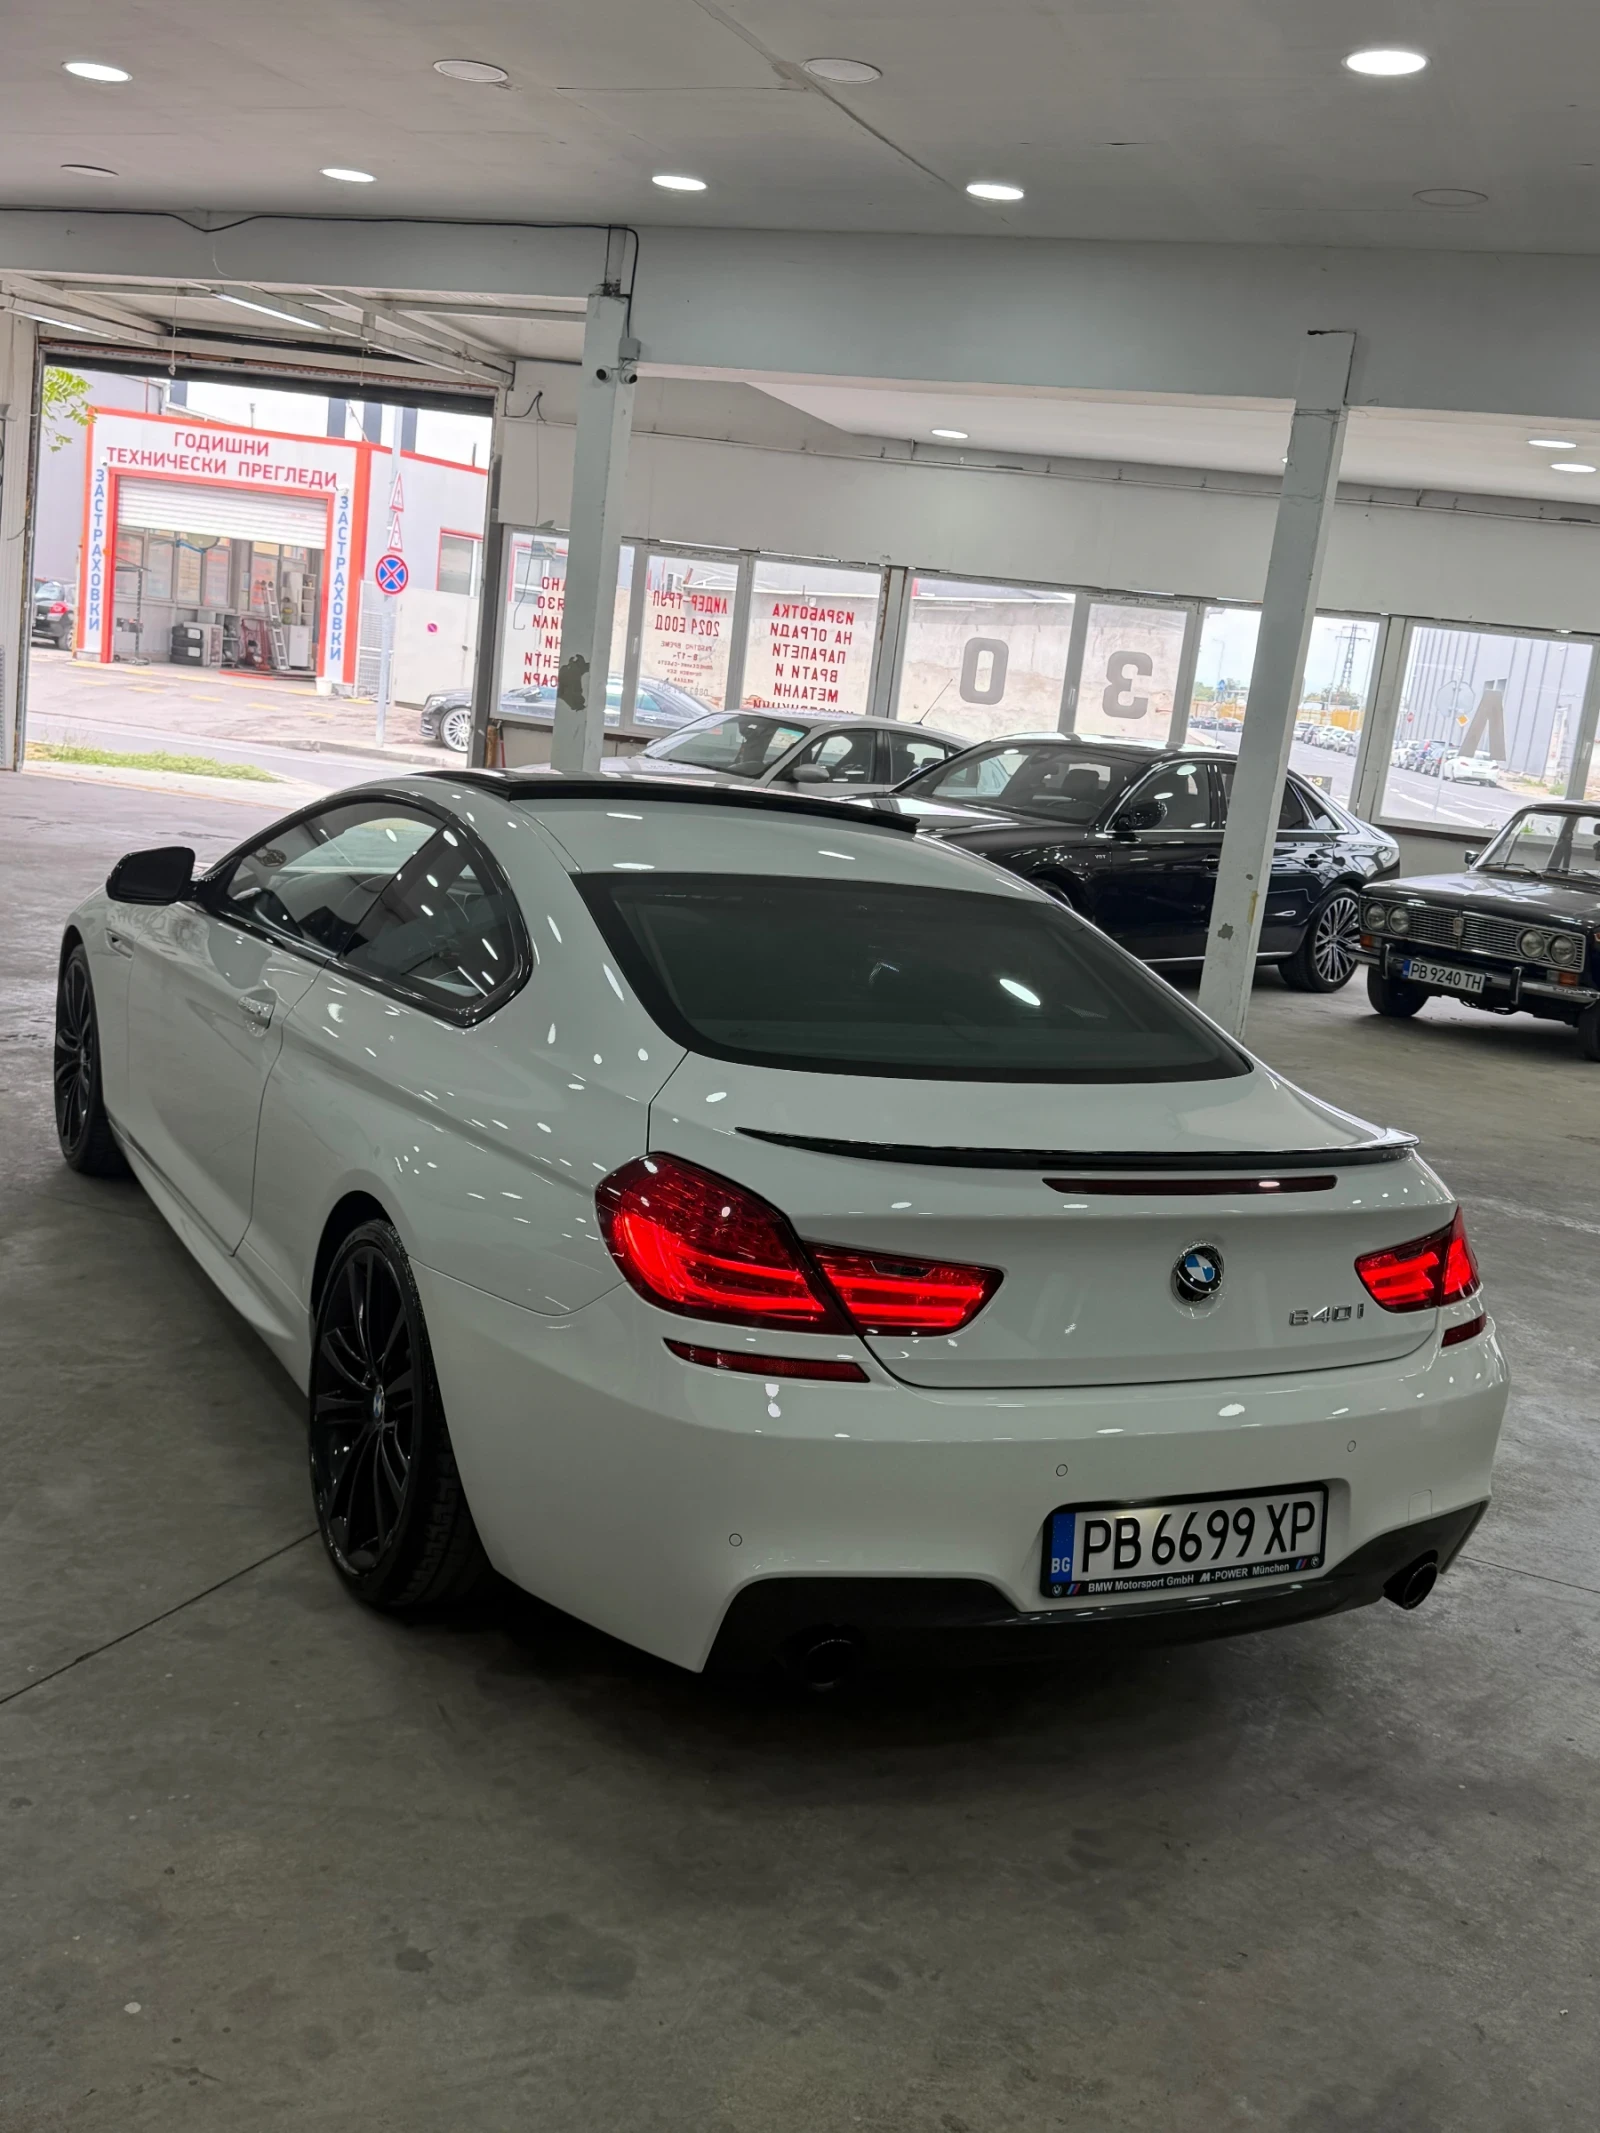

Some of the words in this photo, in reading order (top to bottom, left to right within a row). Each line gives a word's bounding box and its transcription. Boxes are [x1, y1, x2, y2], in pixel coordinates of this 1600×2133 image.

[174, 431, 270, 457] ГОДИШНИ
[107, 447, 226, 475] ТЕХНИЧЕСКИ
[238, 461, 338, 489] ПРЕГЛЕДИ
[89, 469, 105, 630] ЗАСТРАХОВКИ
[330, 496, 349, 660] ЗАСТРАХОВКИ
[1410, 963, 1428, 979] PB
[1430, 967, 1461, 986] 9240
[1464, 973, 1482, 990] TH
[1082, 1516, 1142, 1573] PB
[1151, 1506, 1256, 1566] 6699
[1263, 1500, 1316, 1555] XP
[1051, 1557, 1071, 1574] BG
[1088, 1580, 1113, 1593] BMW
[1114, 1576, 1165, 1592] Motorsport
[1166, 1573, 1194, 1586] GmbH
[1252, 1562, 1290, 1576] München
